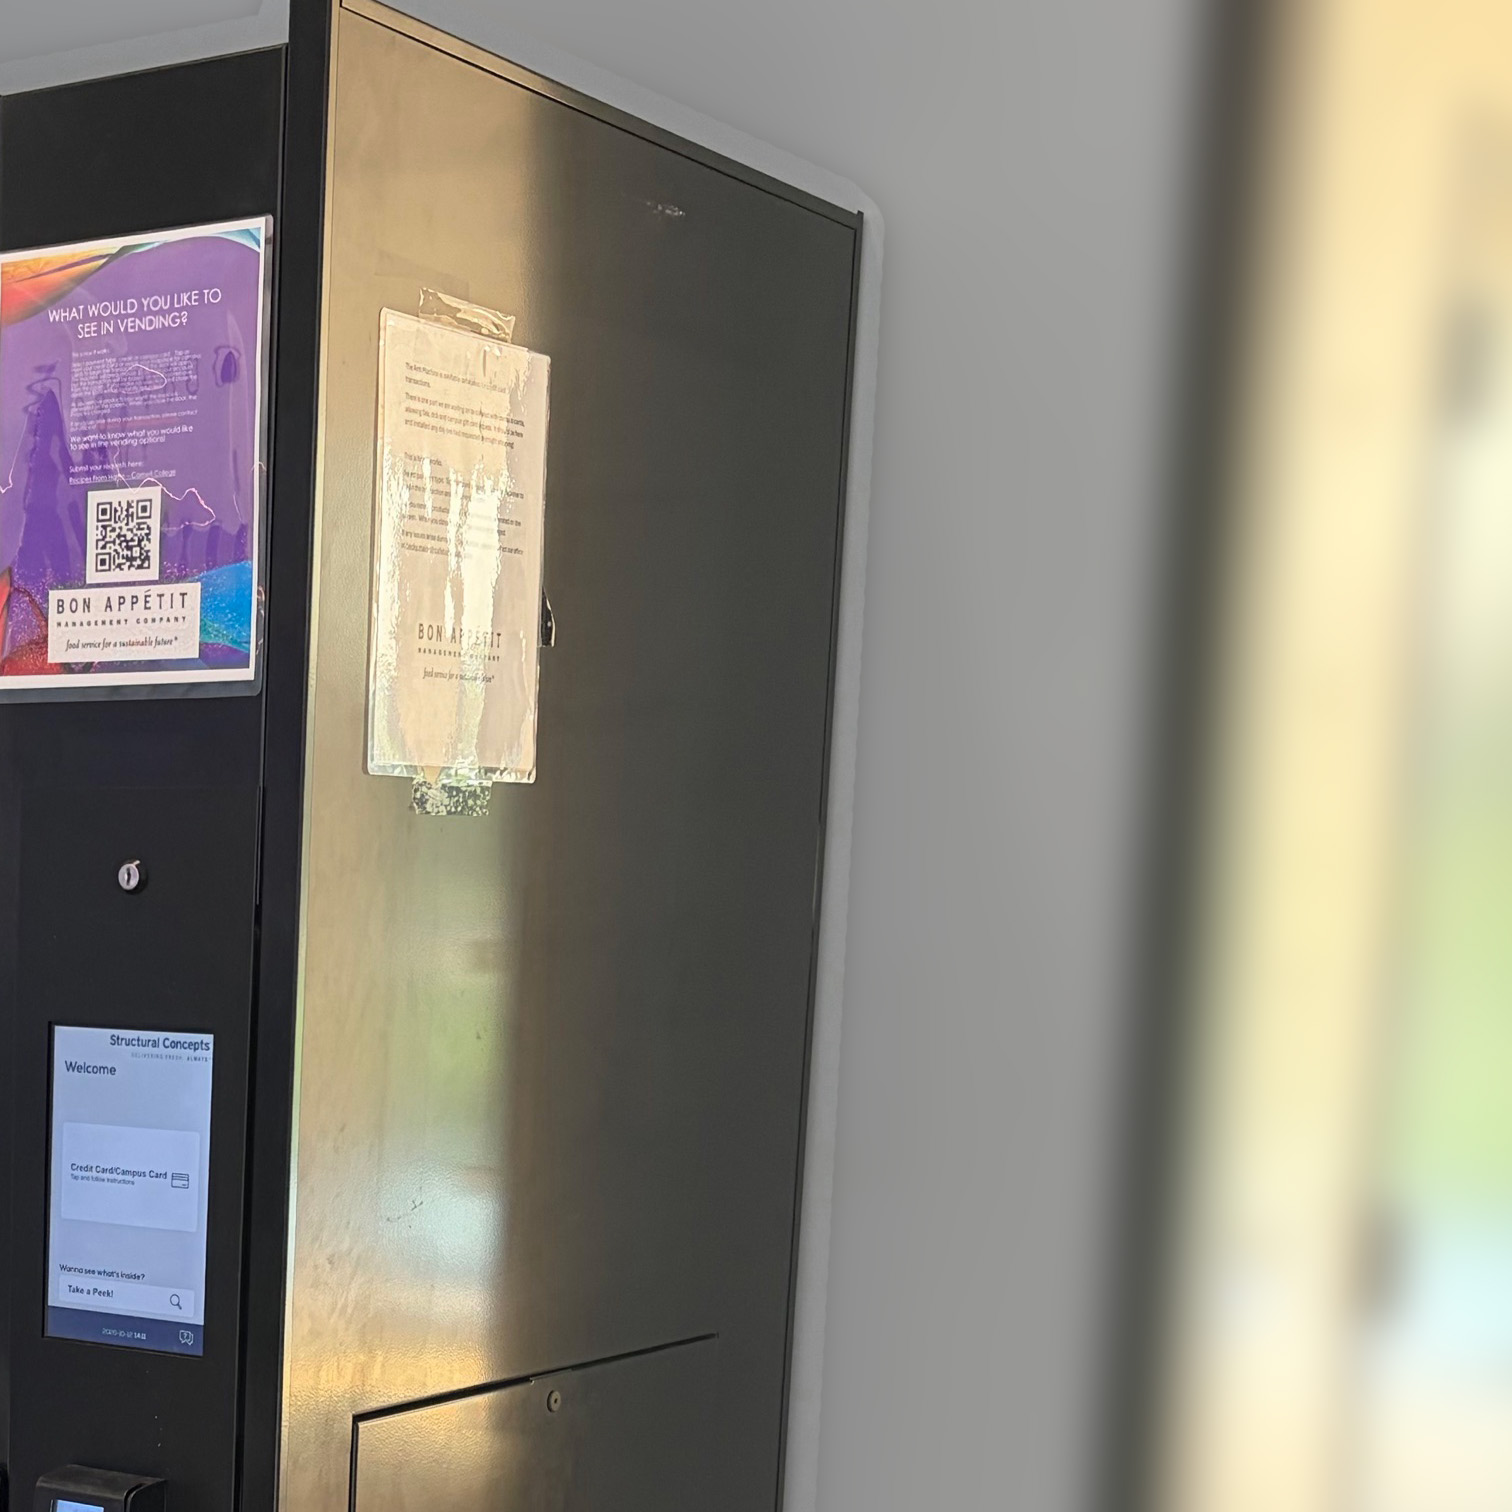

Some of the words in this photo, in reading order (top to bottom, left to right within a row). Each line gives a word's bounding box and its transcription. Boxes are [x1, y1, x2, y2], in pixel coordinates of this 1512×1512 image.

[48, 305, 85, 323] WHAT
[88, 298, 138, 317] WOULD
[141, 295, 171, 312] YOU
[174, 290, 199, 308] LIKE
[203, 288, 222, 304] TO
[77, 323, 98, 339] SEE
[100, 320, 114, 336] IN
[117, 311, 188, 333] VENDING?
[56, 596, 91, 615] BON
[104, 589, 188, 613] APPÉTIT
[56, 619, 128, 628] MANAGEMENT
[135, 616, 186, 625] COMPANY
[418, 622, 443, 643] BON
[65, 639, 80, 652] food
[81, 640, 101, 649] service
[101, 637, 111, 650] for
[119, 636, 153, 648] sustainable
[109, 1033, 160, 1049] Structural
[162, 1037, 211, 1053] Concepts
[64, 1060, 117, 1076] Welcome
[70, 1162, 94, 1173] Credit
[148, 1169, 168, 1180] Card
[59, 1263, 84, 1274] Wanna
[96, 1268, 120, 1278] what's
[120, 1270, 146, 1281] inside?
[68, 1284, 85, 1295] Take
[92, 1287, 114, 1298] Peek!
